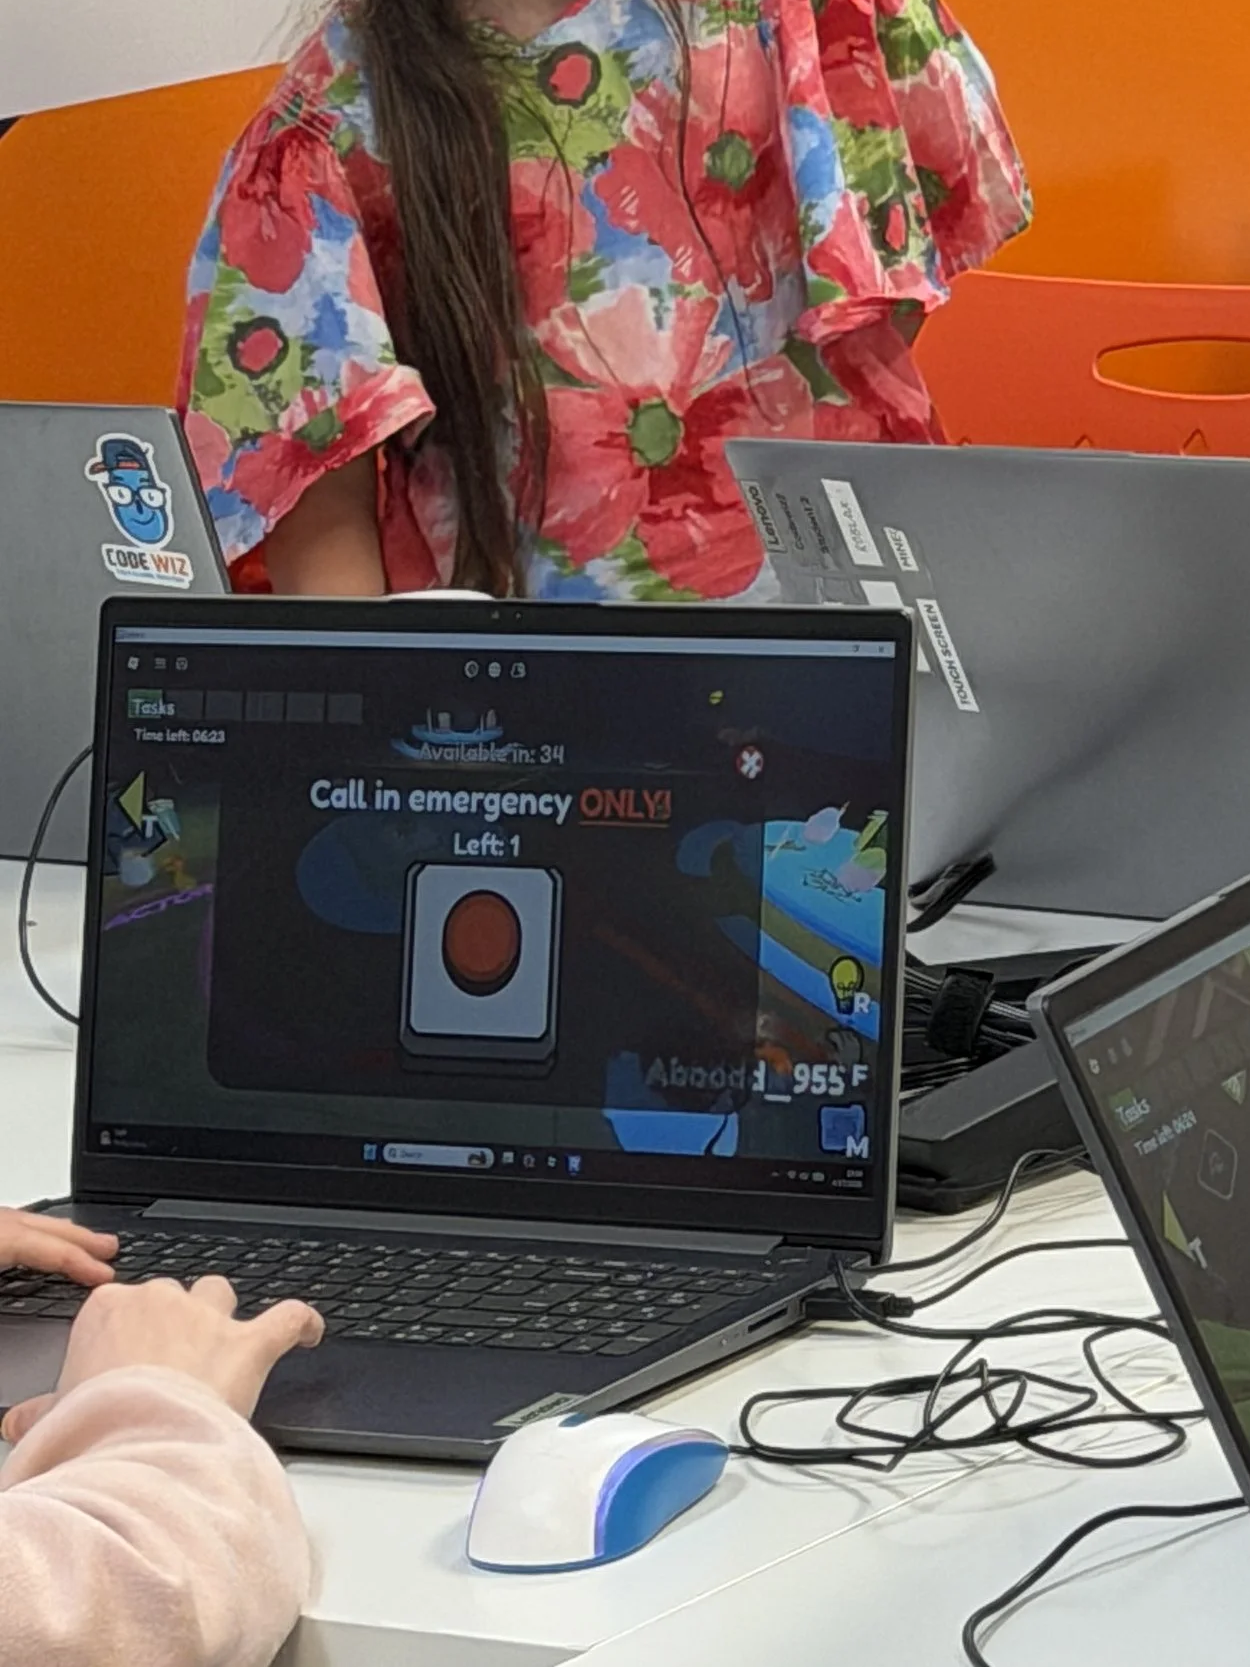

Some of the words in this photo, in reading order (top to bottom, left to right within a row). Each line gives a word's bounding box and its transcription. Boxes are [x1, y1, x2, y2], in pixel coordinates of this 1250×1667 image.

[749, 486, 780, 547] Lenovo
[105, 547, 150, 571] CODE
[150, 554, 189, 576] WIZ
[924, 602, 953, 658] SCREEN
[948, 659, 971, 706] TOUCH
[132, 697, 175, 716] Tasks
[133, 728, 164, 742] Time
[418, 742, 506, 763] Available
[540, 744, 565, 764] 34
[310, 778, 366, 810] Call
[375, 779, 400, 811] in
[408, 788, 573, 825] emergency
[578, 788, 672, 824] ONLY!
[853, 991, 871, 1015] R
[851, 1063, 870, 1087] F
[845, 1135, 870, 1160] M
